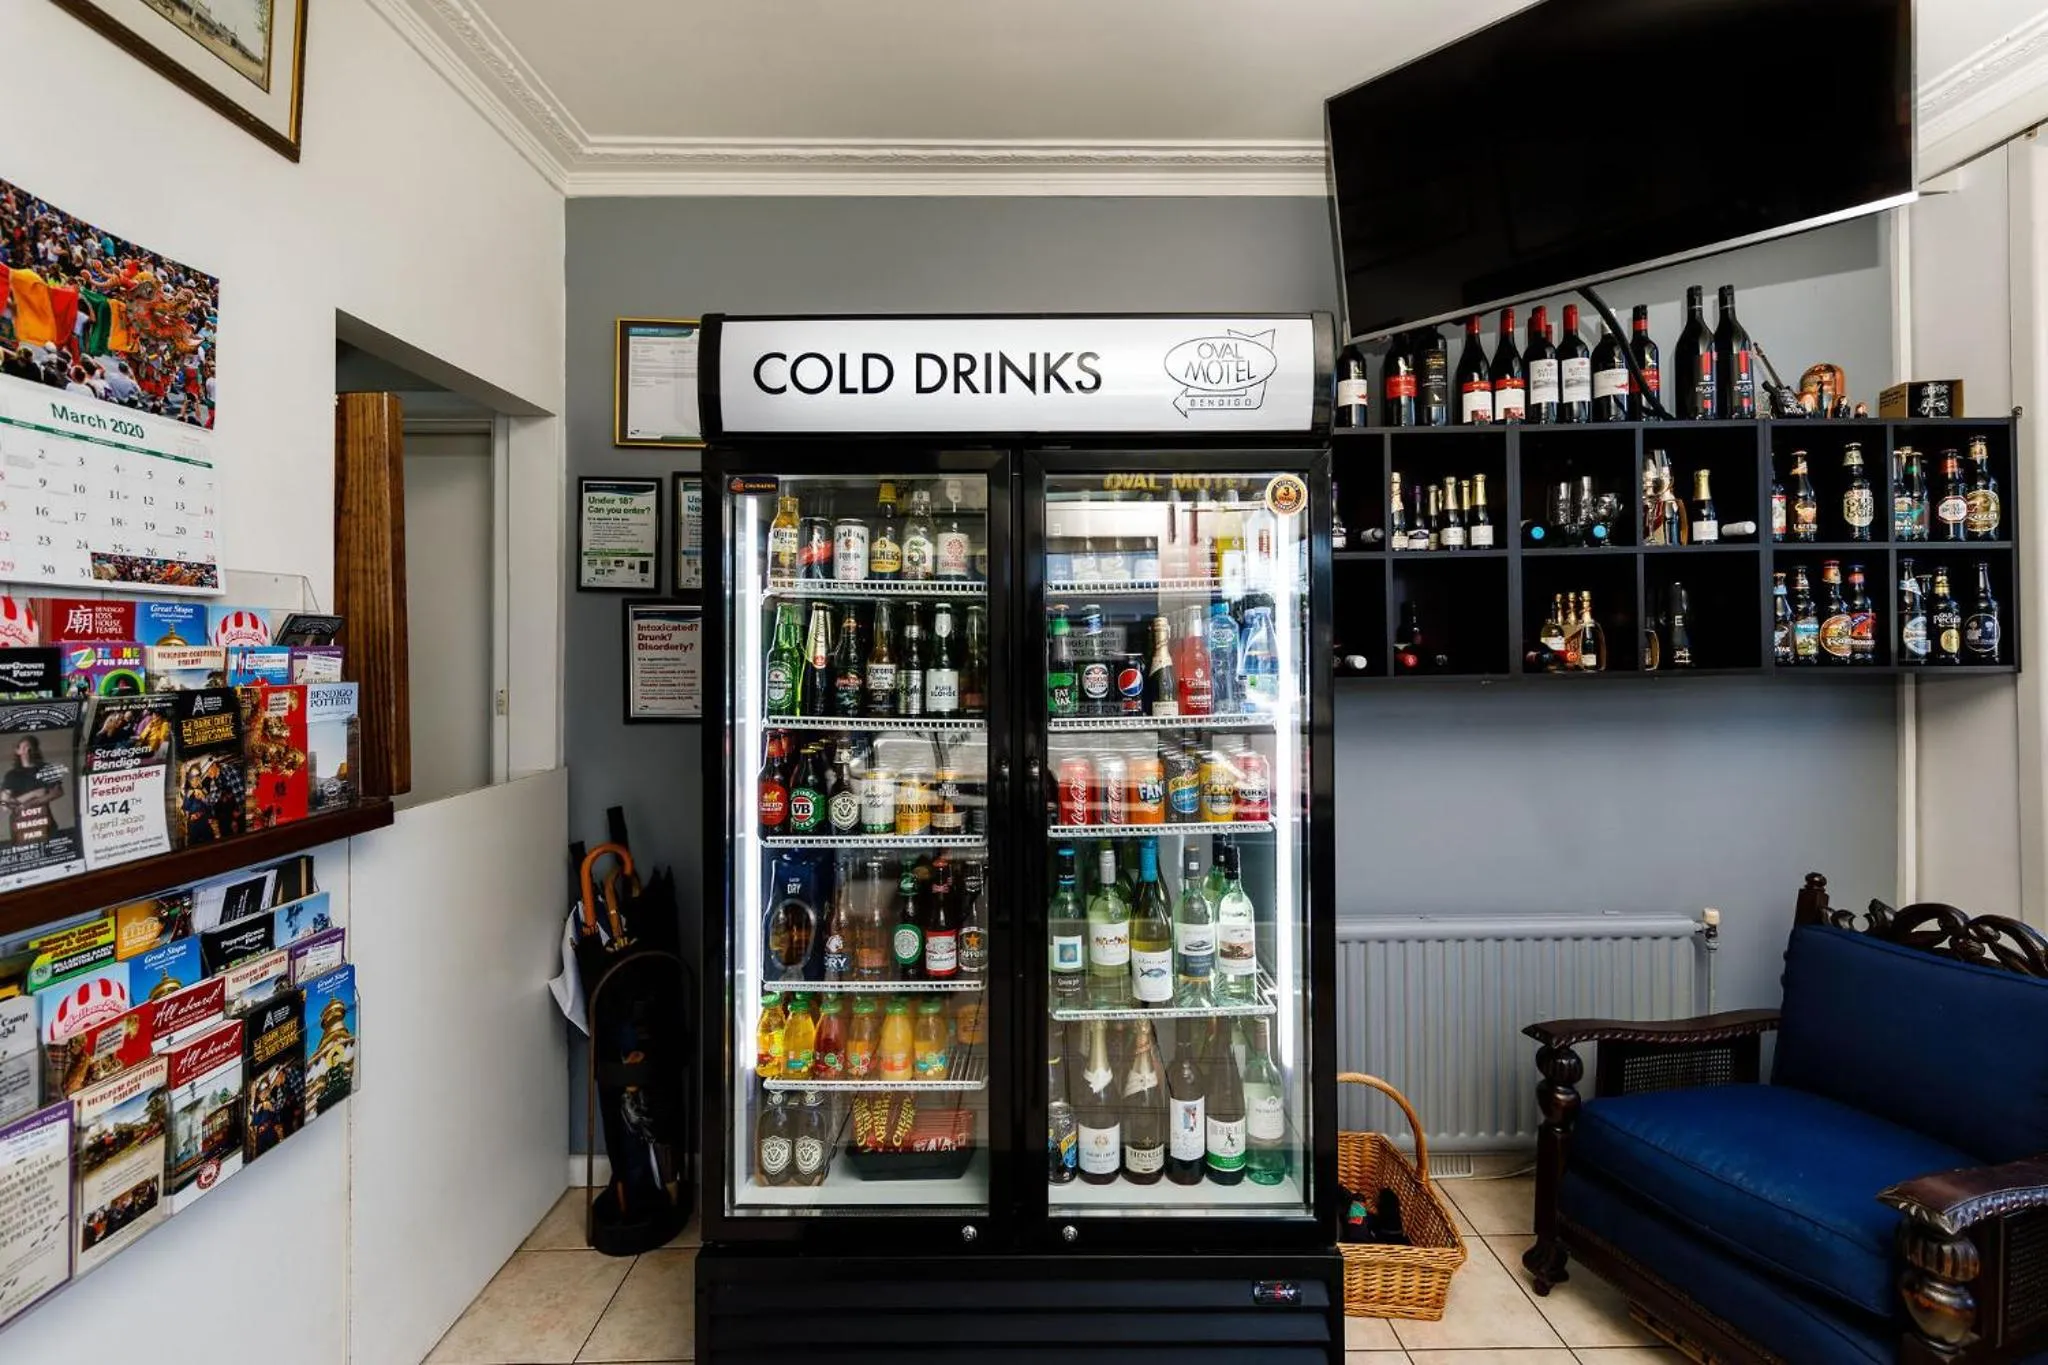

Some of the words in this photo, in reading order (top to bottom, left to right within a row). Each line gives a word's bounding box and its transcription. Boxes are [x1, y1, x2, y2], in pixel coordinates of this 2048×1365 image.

[1197, 342, 1244, 360] OVAL
[753, 351, 895, 396] COLD
[915, 351, 1103, 397] DRINKS
[1184, 359, 1257, 385] MOTEL
[1190, 398, 1252, 407] BENDIGO
[51, 403, 107, 430] March
[111, 418, 145, 439] 2020
[38, 449, 45, 459] 2
[78, 457, 85, 466] 3
[114, 465, 120, 474] 4
[147, 471, 153, 480] 5
[178, 476, 185, 486] 6
[1103, 473, 1162, 489] OVAL
[39, 479, 47, 489] 9
[73, 484, 86, 494] 10
[109, 490, 120, 500] 11
[143, 496, 154, 506] 12
[175, 501, 185, 511] 13
[1283, 486, 1290, 496] 3
[588, 496, 615, 504] Under
[588, 506, 604, 514] Can
[607, 507, 621, 515] you
[624, 506, 651, 514] enter?
[35, 506, 49, 517] 16
[74, 512, 87, 522] 17
[110, 516, 122, 527] 18
[144, 521, 155, 531] 19
[175, 526, 186, 536] 20
[37, 536, 51, 546] 23
[76, 540, 89, 550] 24
[112, 544, 124, 553] 25
[0, 561, 14, 571] 29
[41, 565, 55, 575] 30
[80, 567, 91, 577] 31
[637, 623, 699, 632] Intoxicated?
[637, 633, 672, 641] Drunk?
[638, 643, 694, 652] Disorderly?
[310, 690, 353, 699] BENDIGO
[1054, 688, 1068, 697] FAT
[310, 698, 351, 708] POTTERY
[1056, 697, 1071, 705] YAK
[94, 744, 152, 759] Strategem
[92, 757, 141, 771] Bendigo
[92, 768, 161, 786] Winemakers
[91, 782, 135, 798] Festival
[21, 807, 42, 817] LOST
[793, 803, 811, 814] VB
[16, 818, 48, 829] TRADES
[91, 817, 118, 832] April
[23, 830, 42, 839] FAIR
[788, 883, 801, 894] DRY
[153, 1001, 177, 1025] All
[178, 983, 223, 1016] aboard!
[1, 1012, 28, 1027] Camp
[177, 1049, 201, 1073] All
[201, 1025, 241, 1060] aboard!
